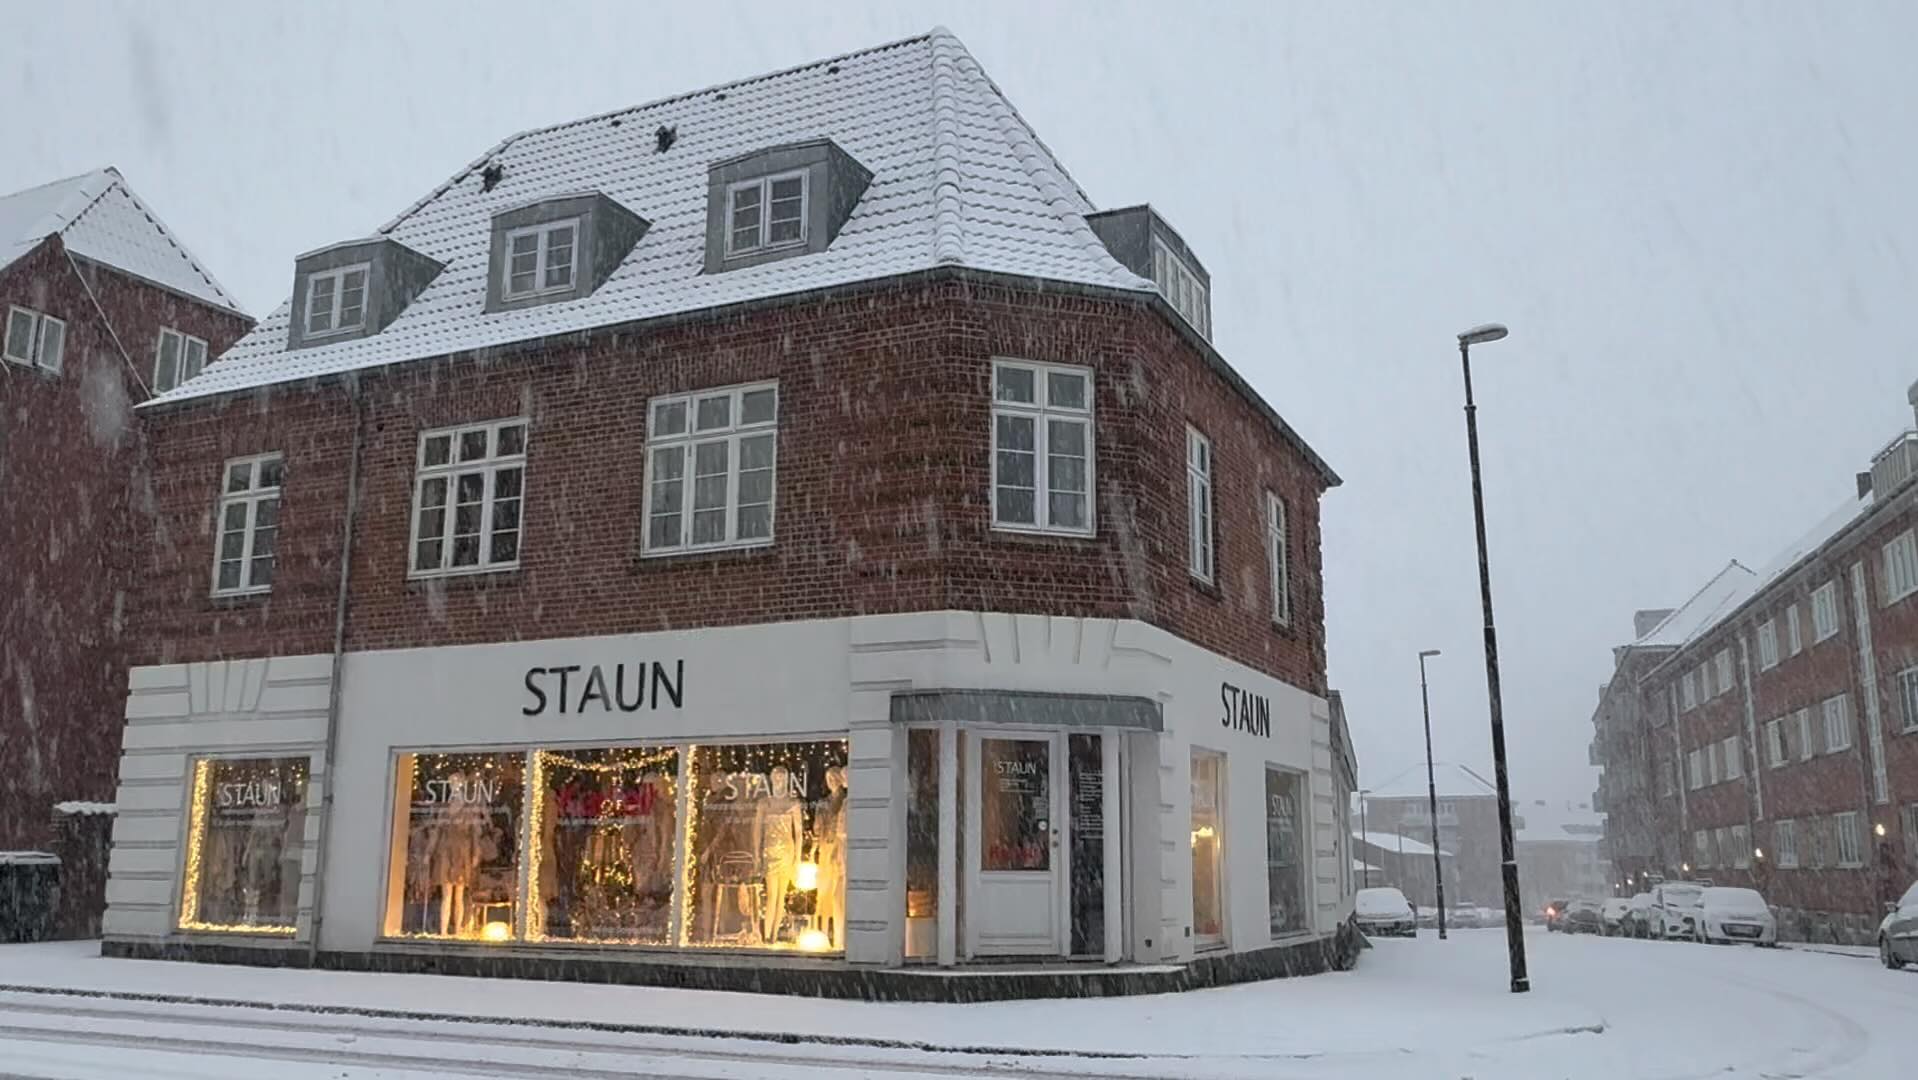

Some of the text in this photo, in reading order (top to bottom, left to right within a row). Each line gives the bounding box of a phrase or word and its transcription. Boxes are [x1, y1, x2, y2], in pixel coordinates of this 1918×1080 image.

[523, 659, 684, 716] STAUN
[1221, 681, 1270, 738] STAUN
[998, 760, 1036, 775] STAUN
[222, 781, 281, 806] STAUN
[426, 779, 494, 804] STAUN
[725, 772, 808, 800] STAUN
